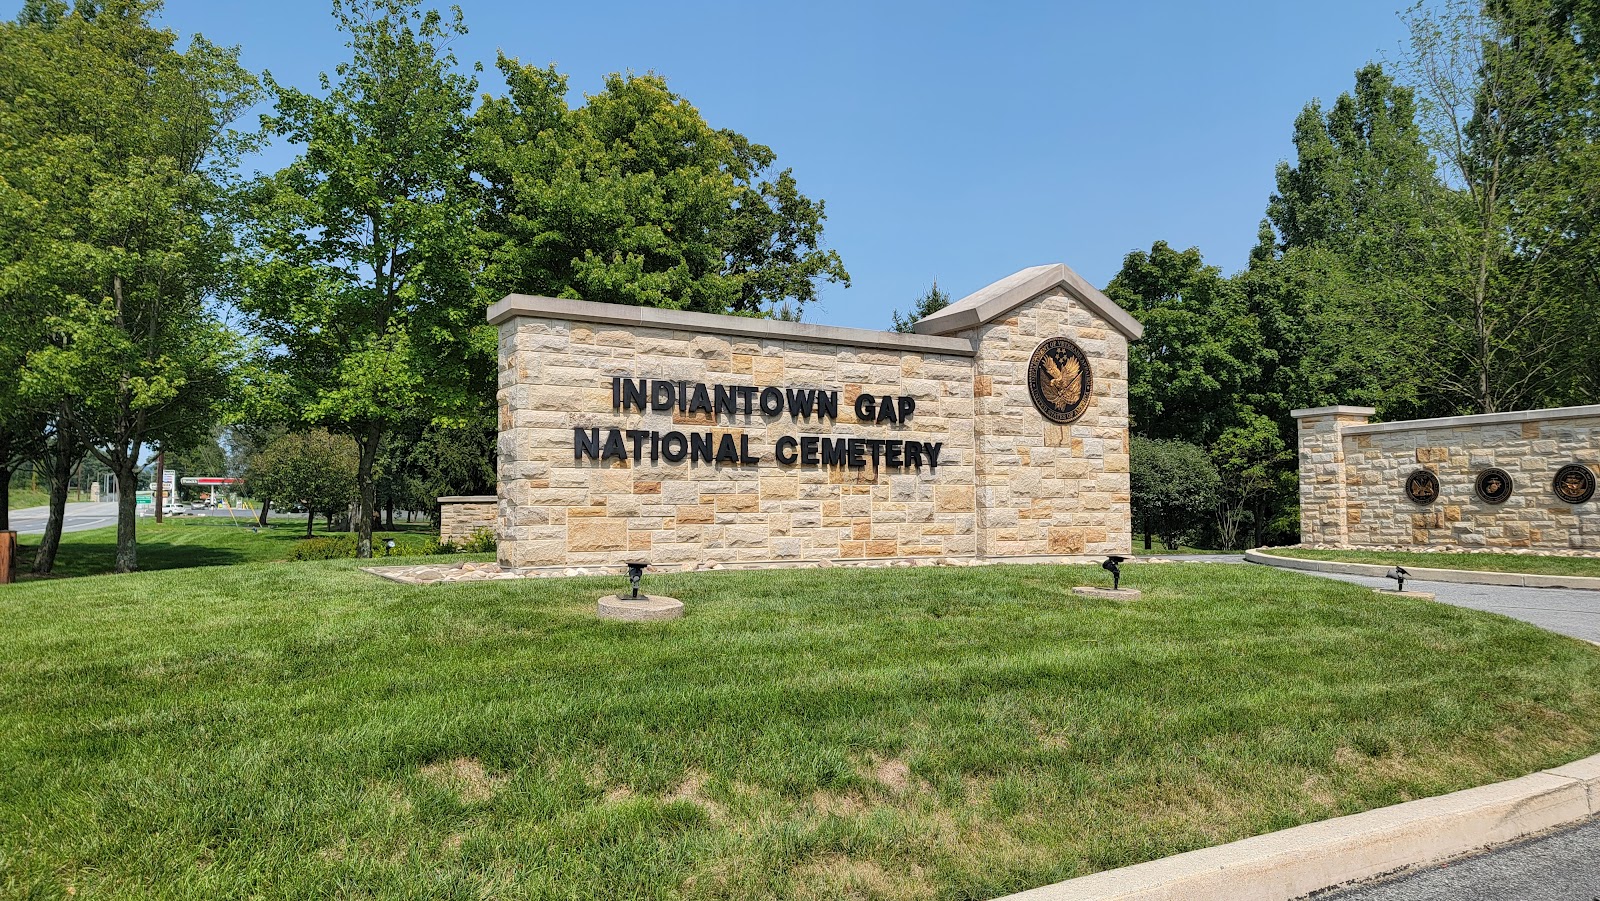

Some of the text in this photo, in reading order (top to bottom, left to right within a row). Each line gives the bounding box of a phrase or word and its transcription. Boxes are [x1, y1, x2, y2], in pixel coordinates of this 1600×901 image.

[612, 377, 916, 424] INDIANTOWN GAP
[574, 427, 942, 468] NATIONAL CEMETERY
